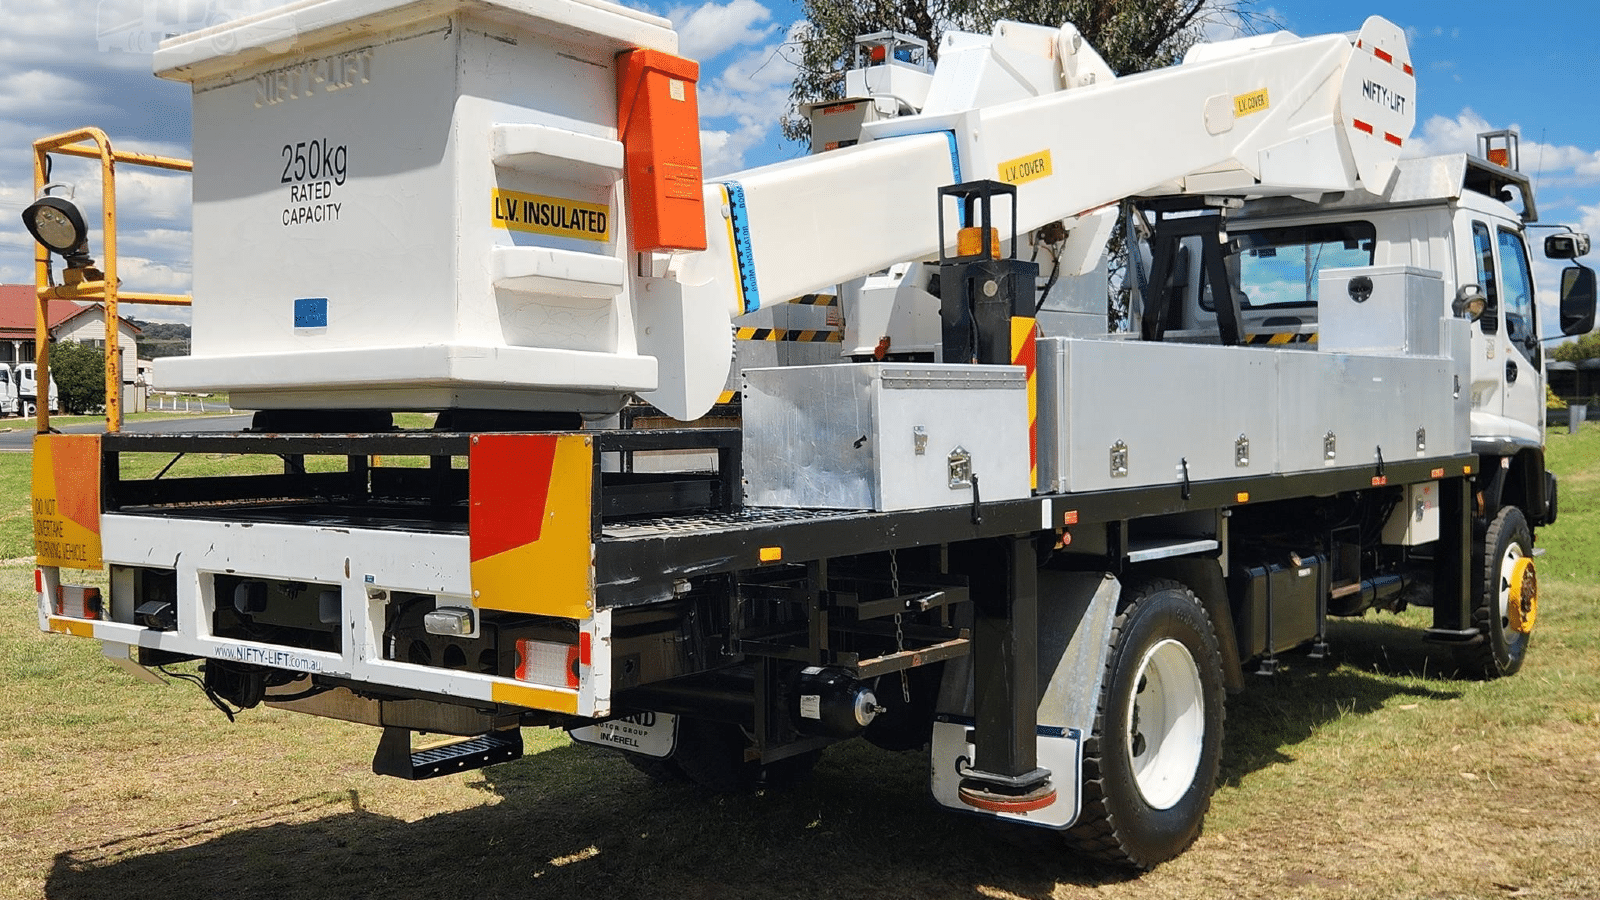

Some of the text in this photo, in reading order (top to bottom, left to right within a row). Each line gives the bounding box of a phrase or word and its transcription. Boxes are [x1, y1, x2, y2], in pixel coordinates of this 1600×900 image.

[280, 137, 347, 186] 250kg
[1018, 158, 1046, 178] COVER
[290, 181, 332, 203] RATED
[282, 202, 342, 226] CAPACITY
[495, 197, 607, 234] L.V. INSULATED
[600, 732, 639, 748] INVERELL
[622, 726, 648, 737] GROUP
